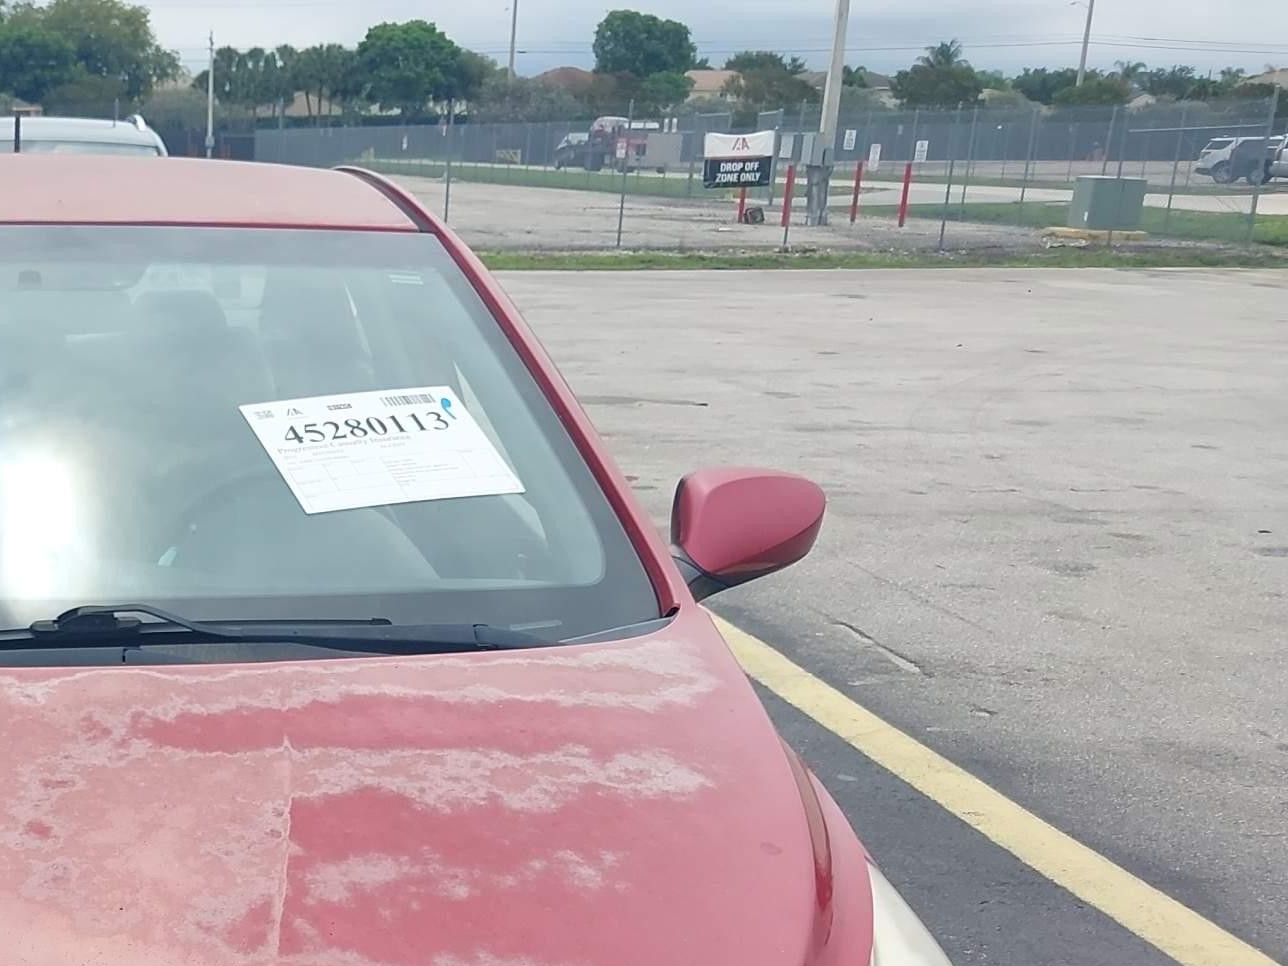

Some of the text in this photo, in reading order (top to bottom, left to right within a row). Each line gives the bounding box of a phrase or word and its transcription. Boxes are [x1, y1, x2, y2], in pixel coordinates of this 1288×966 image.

[720, 161, 760, 172] DROP OFF
[716, 172, 761, 183] ZONE ONLY
[284, 411, 450, 444] 45280113
